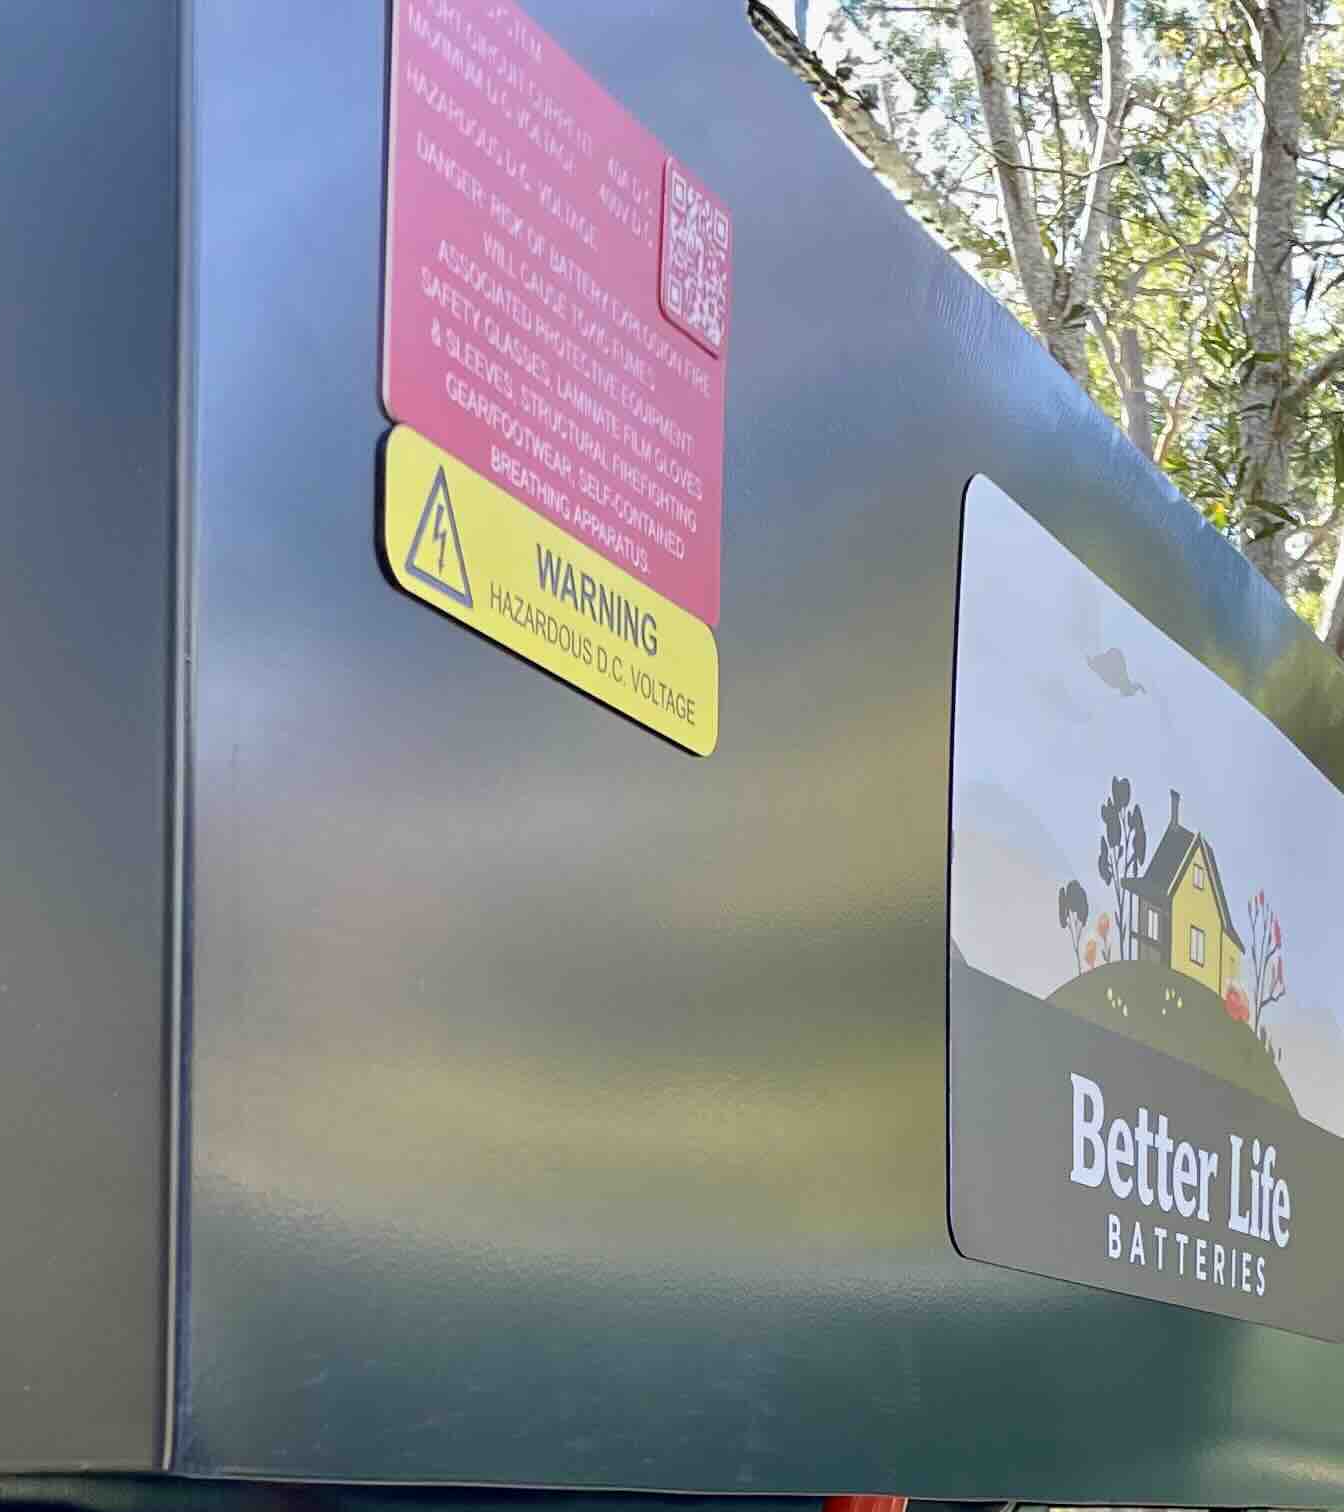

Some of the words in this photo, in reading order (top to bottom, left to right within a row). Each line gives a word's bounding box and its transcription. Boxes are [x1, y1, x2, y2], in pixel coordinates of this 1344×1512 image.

[406, 58, 502, 171] HAZARDOUS
[538, 174, 599, 254] VOLTAGE
[437, 235, 531, 335] ASSOCIATED
[535, 311, 617, 401] PROTECTIVE
[482, 227, 516, 283] WILL
[519, 258, 566, 323] CAUSE
[490, 191, 523, 246] RISK
[549, 241, 608, 316] BATTERY
[684, 354, 711, 400] FIRE
[420, 264, 480, 339] SAFETY
[557, 368, 619, 442] LAMINATE
[623, 418, 652, 466] FILM
[654, 442, 703, 503] GLOVES
[430, 314, 441, 353] &
[520, 381, 609, 473] STRUCTURAL
[612, 448, 697, 535] FIREFIGHTING
[490, 443, 570, 523] BREATHING
[578, 463, 685, 562] SELF-CONTAINED
[489, 578, 593, 669] HAZARDOUS
[596, 642, 624, 687] D.C.
[630, 662, 696, 728] VOLTAGE
[535, 539, 658, 661] WARNING
[1070, 1072, 1219, 1222] Better
[1228, 1135, 1291, 1248] Life
[1108, 1213, 1266, 1296] BATTERIES
